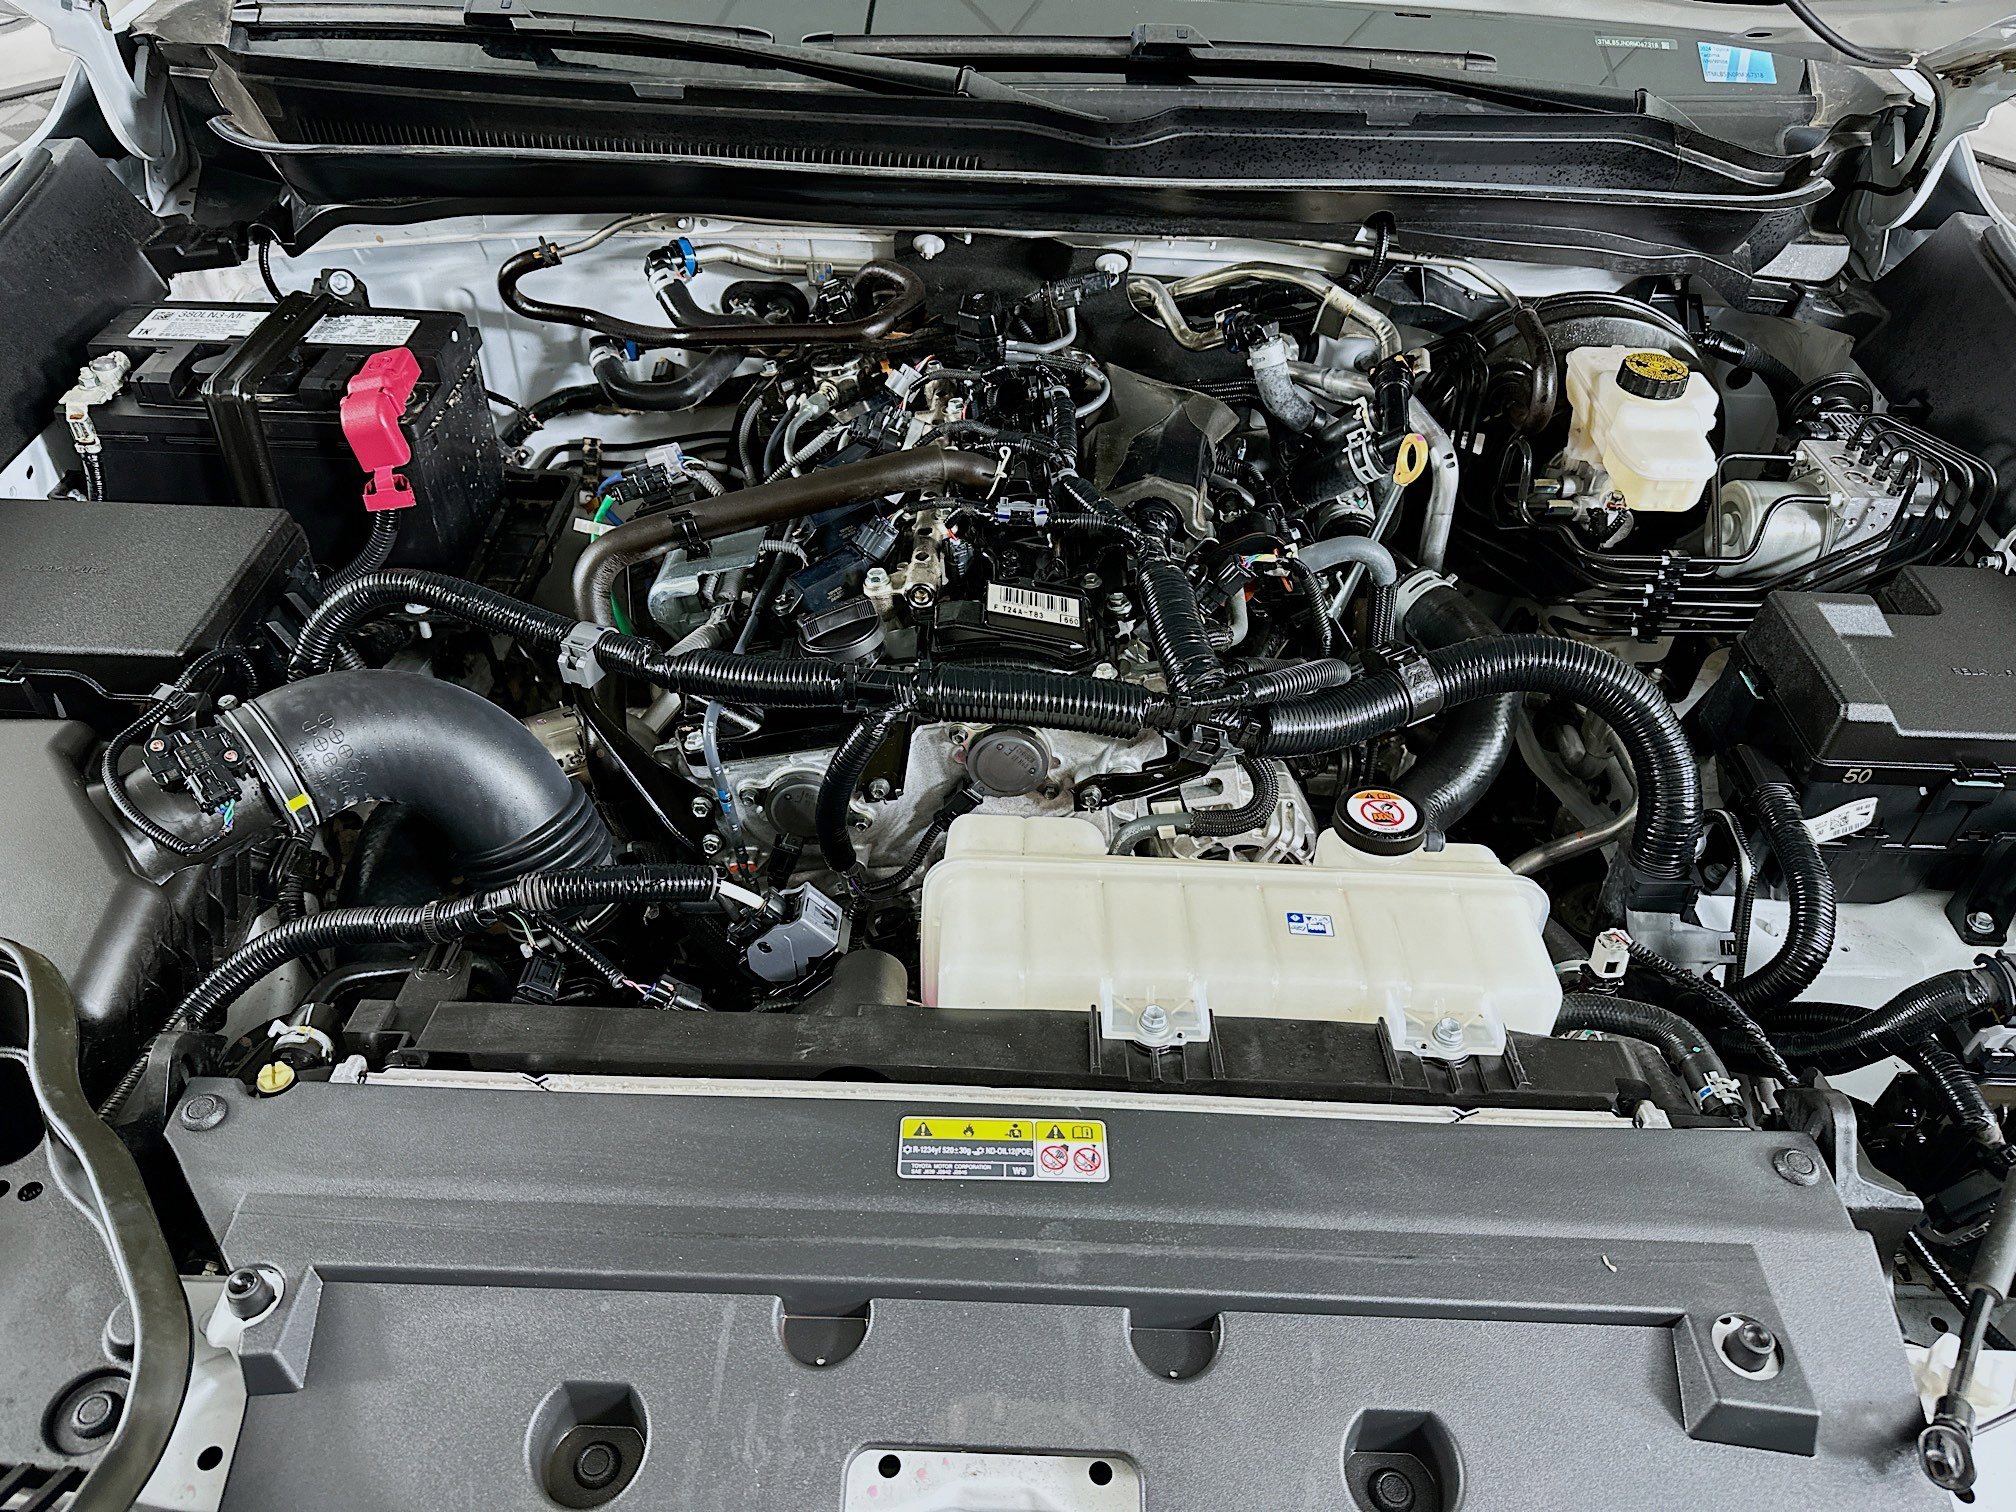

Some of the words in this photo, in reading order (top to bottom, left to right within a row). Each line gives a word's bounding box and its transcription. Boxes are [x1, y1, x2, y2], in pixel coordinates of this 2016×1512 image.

[178, 311, 247, 319] 380LN3-MF
[1002, 605, 1044, 619] T24A-T83
[1843, 768, 1873, 784] 50
[913, 1146, 941, 1155] R-1234yf
[1012, 1167, 1027, 1175] W9
